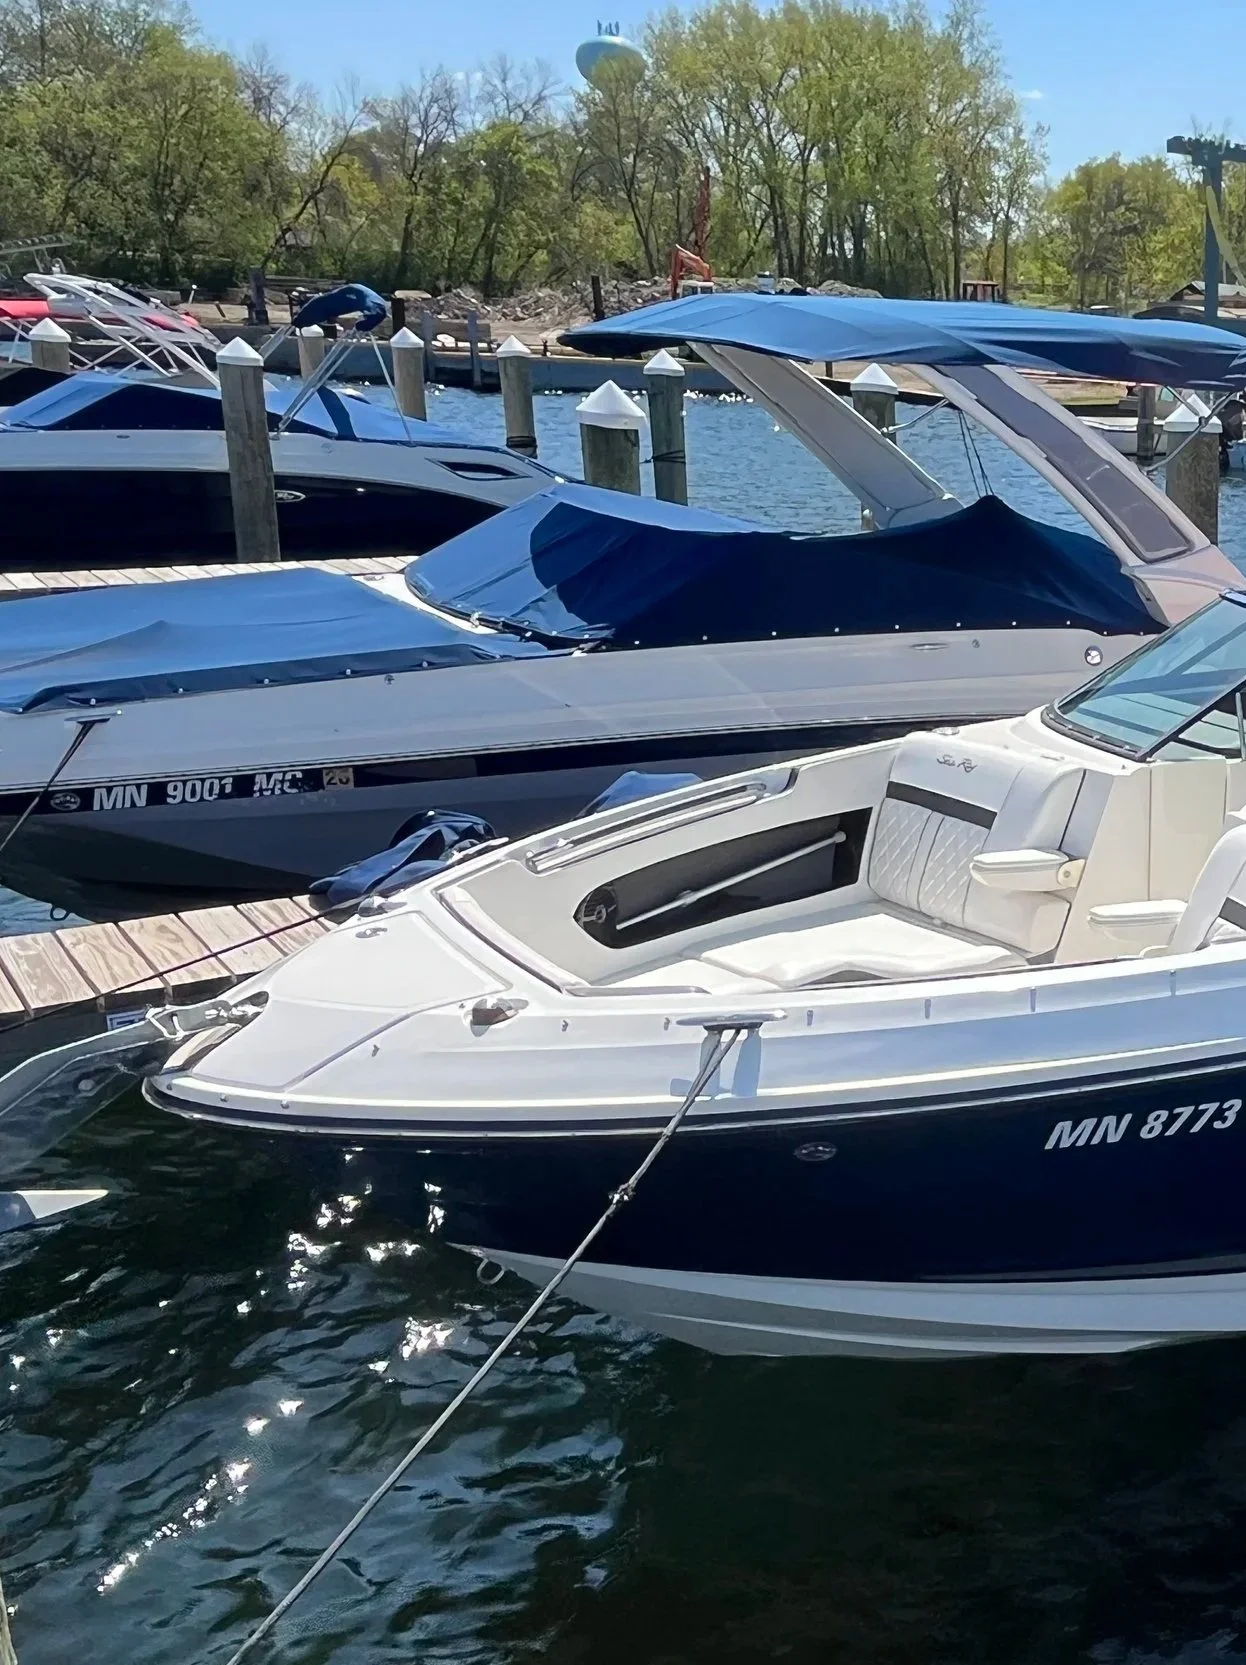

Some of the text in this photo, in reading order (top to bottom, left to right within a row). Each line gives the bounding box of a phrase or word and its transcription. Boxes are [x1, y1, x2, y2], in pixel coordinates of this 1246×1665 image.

[93, 784, 148, 811] MN
[1044, 1113, 1132, 1150] MN
[1139, 1099, 1242, 1139] 8773
